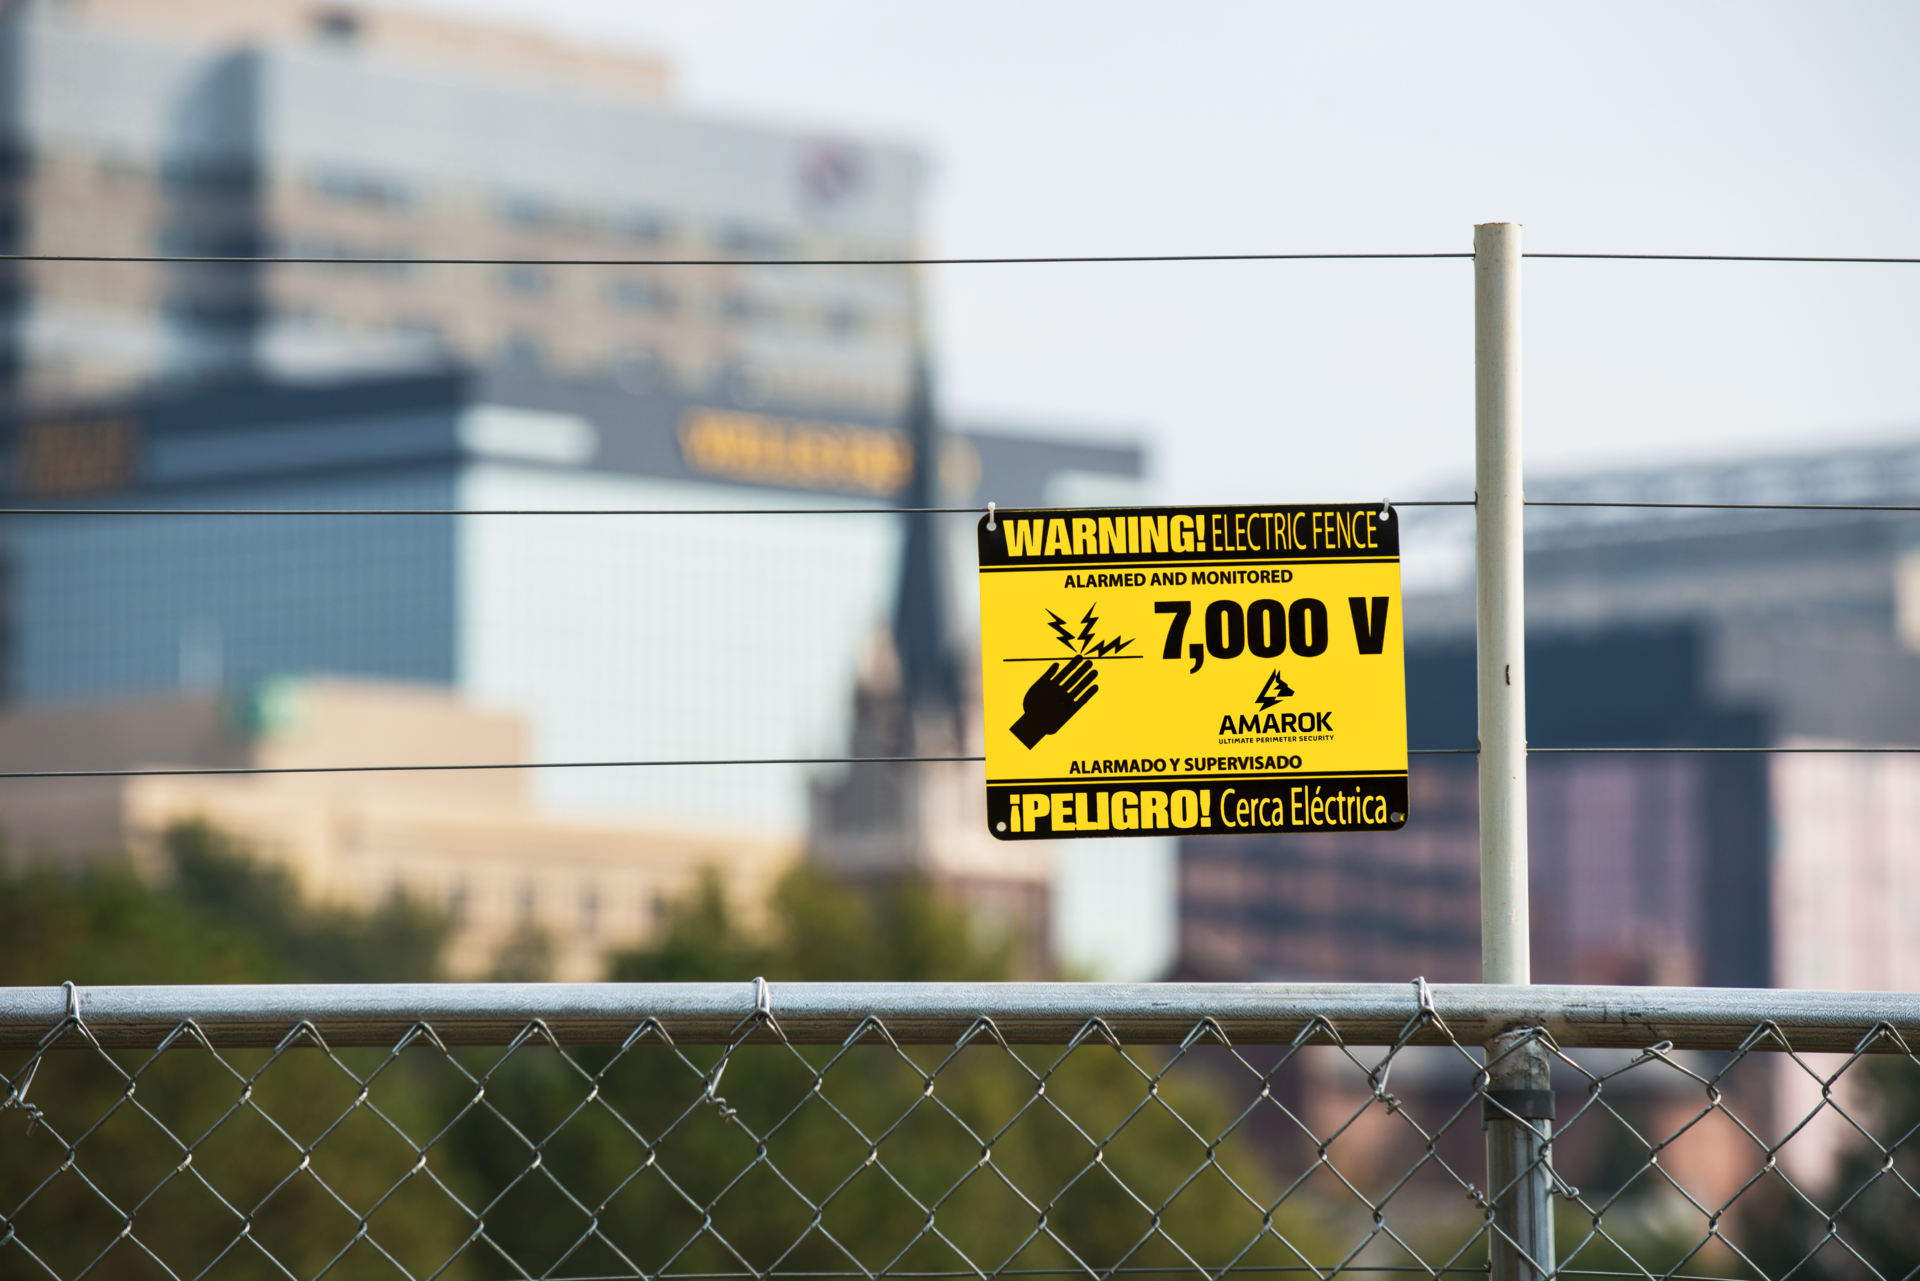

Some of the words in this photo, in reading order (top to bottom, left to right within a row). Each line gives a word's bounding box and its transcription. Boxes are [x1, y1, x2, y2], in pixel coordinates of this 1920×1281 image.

[1003, 514, 1206, 557] WARNING!
[1212, 511, 1307, 551] ELECTRIC
[1313, 511, 1378, 549] FENCE
[1064, 573, 1146, 588] ALARMED
[1150, 572, 1187, 586] AND
[1191, 570, 1293, 585] MONITORED
[1154, 598, 1328, 674] 7,000
[1348, 597, 1389, 655] V
[1219, 711, 1333, 735] AMAROK
[1218, 737, 1254, 745] ULTIMATE
[1069, 759, 1166, 774] ALARMADO
[1169, 758, 1180, 772] Y
[1184, 755, 1302, 772] SUPERVISADO
[1010, 789, 1211, 832] ¡PELIGRO!
[1220, 788, 1284, 827] Cerca
[1291, 786, 1387, 825] Eléctrica
